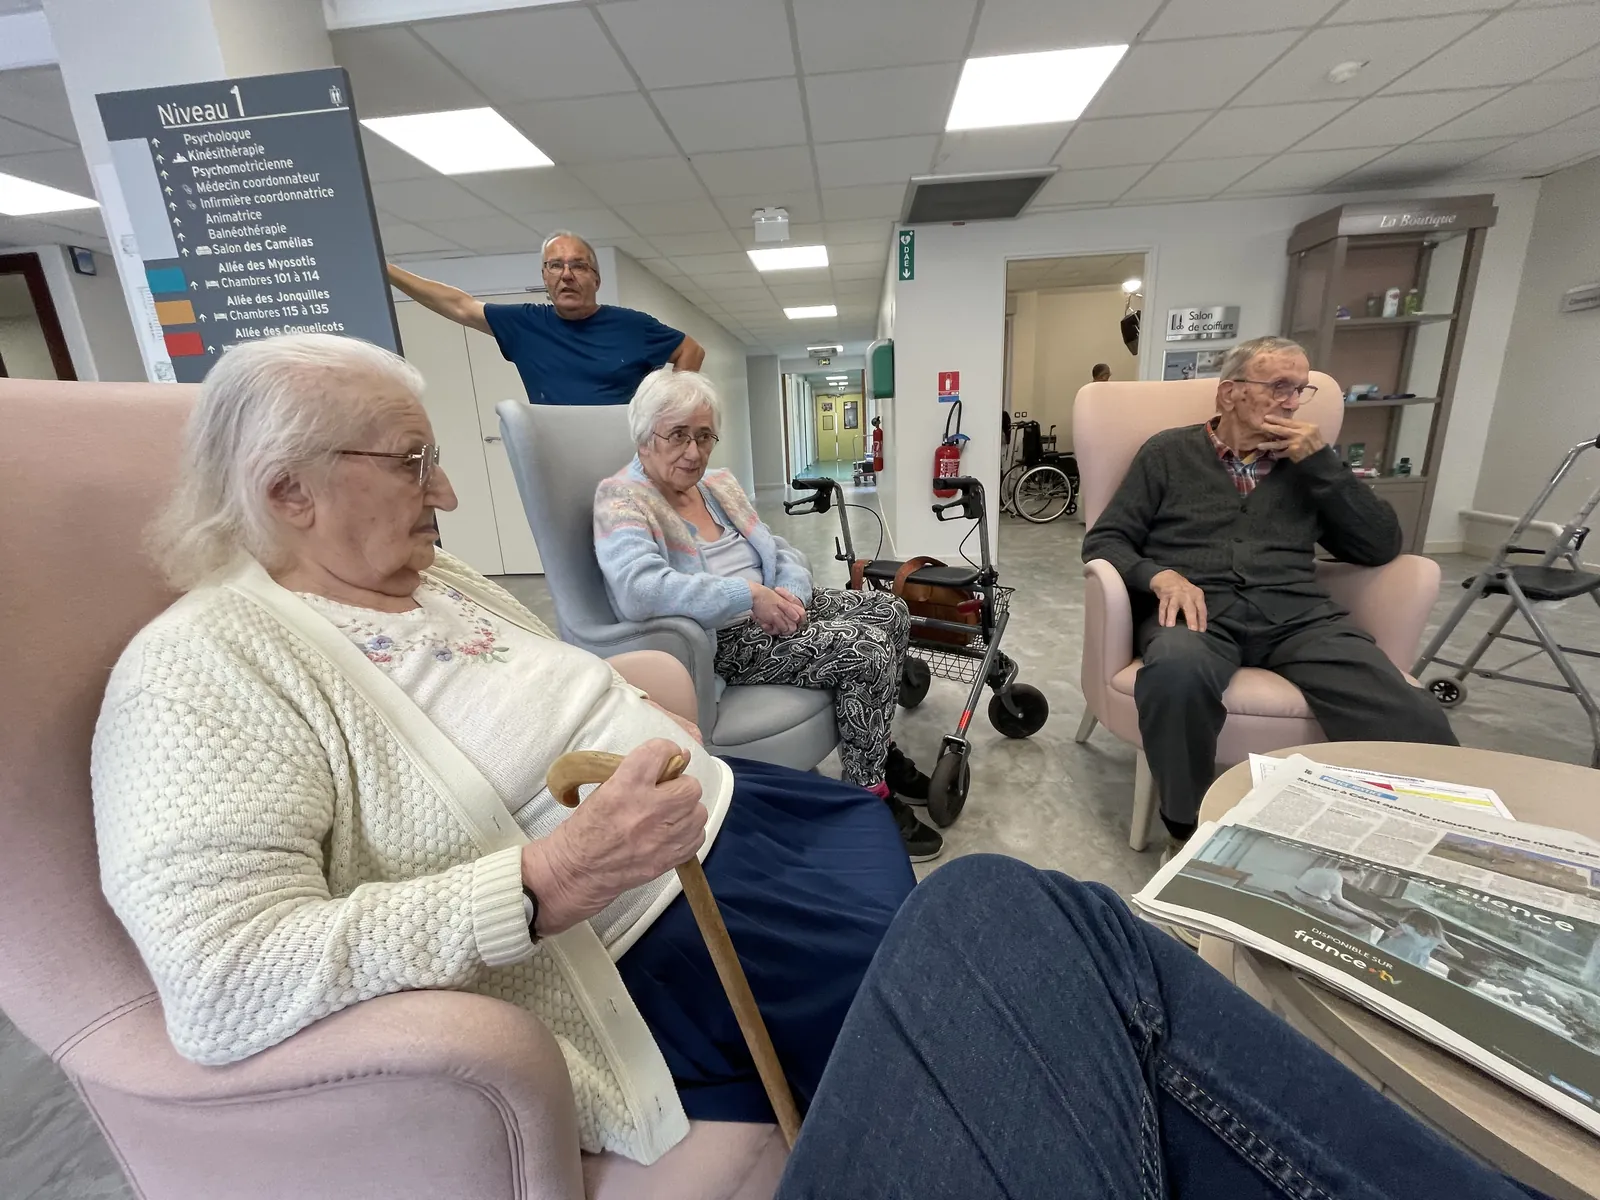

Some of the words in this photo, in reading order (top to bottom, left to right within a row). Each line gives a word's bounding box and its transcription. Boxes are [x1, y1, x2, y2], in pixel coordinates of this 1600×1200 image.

[157, 101, 229, 126] Niveau
[230, 84, 245, 117] 1
[183, 128, 252, 146] Psychologue
[187, 142, 265, 162] Kinésithérapie
[191, 158, 294, 179] Psychomotricienne
[195, 178, 241, 194] Médecin
[242, 171, 321, 189] coordonnateur
[199, 193, 252, 209] Infirmière
[253, 186, 335, 204] coordonnatrice
[205, 209, 263, 225] Animatrice
[1380, 215, 1397, 228] La
[1399, 214, 1457, 228] Boutique
[207, 222, 288, 240] Balnéothérapie
[212, 242, 241, 255] Salon
[243, 239, 263, 252] des
[264, 235, 314, 251] Camélias
[218, 260, 245, 274] Allée
[246, 259, 266, 272] des
[267, 254, 317, 271] Myosotis
[221, 274, 273, 289] Chambres
[274, 272, 291, 284] 101
[294, 271, 301, 282] à
[302, 269, 320, 281] 114
[227, 293, 253, 306] Allée
[254, 292, 273, 305] des
[276, 288, 330, 303] Jonquilles
[229, 307, 281, 321] Chambres
[281, 304, 299, 317] 115
[301, 304, 309, 315] à
[309, 303, 330, 315] 135
[1188, 310, 1213, 321] Salon
[235, 326, 261, 339] Allée
[263, 325, 281, 337] des
[283, 321, 345, 335] Coquelicots
[1187, 322, 1200, 332] de
[1202, 320, 1234, 332] coiffure
[1297, 777, 1339, 792] Stupeur
[1382, 801, 1417, 817] après
[1432, 816, 1488, 834] meurtre
[1489, 831, 1531, 844] d'une
[1455, 887, 1575, 933] silence
[1311, 927, 1371, 960] DISPONIBLE
[1371, 955, 1395, 971] SUR
